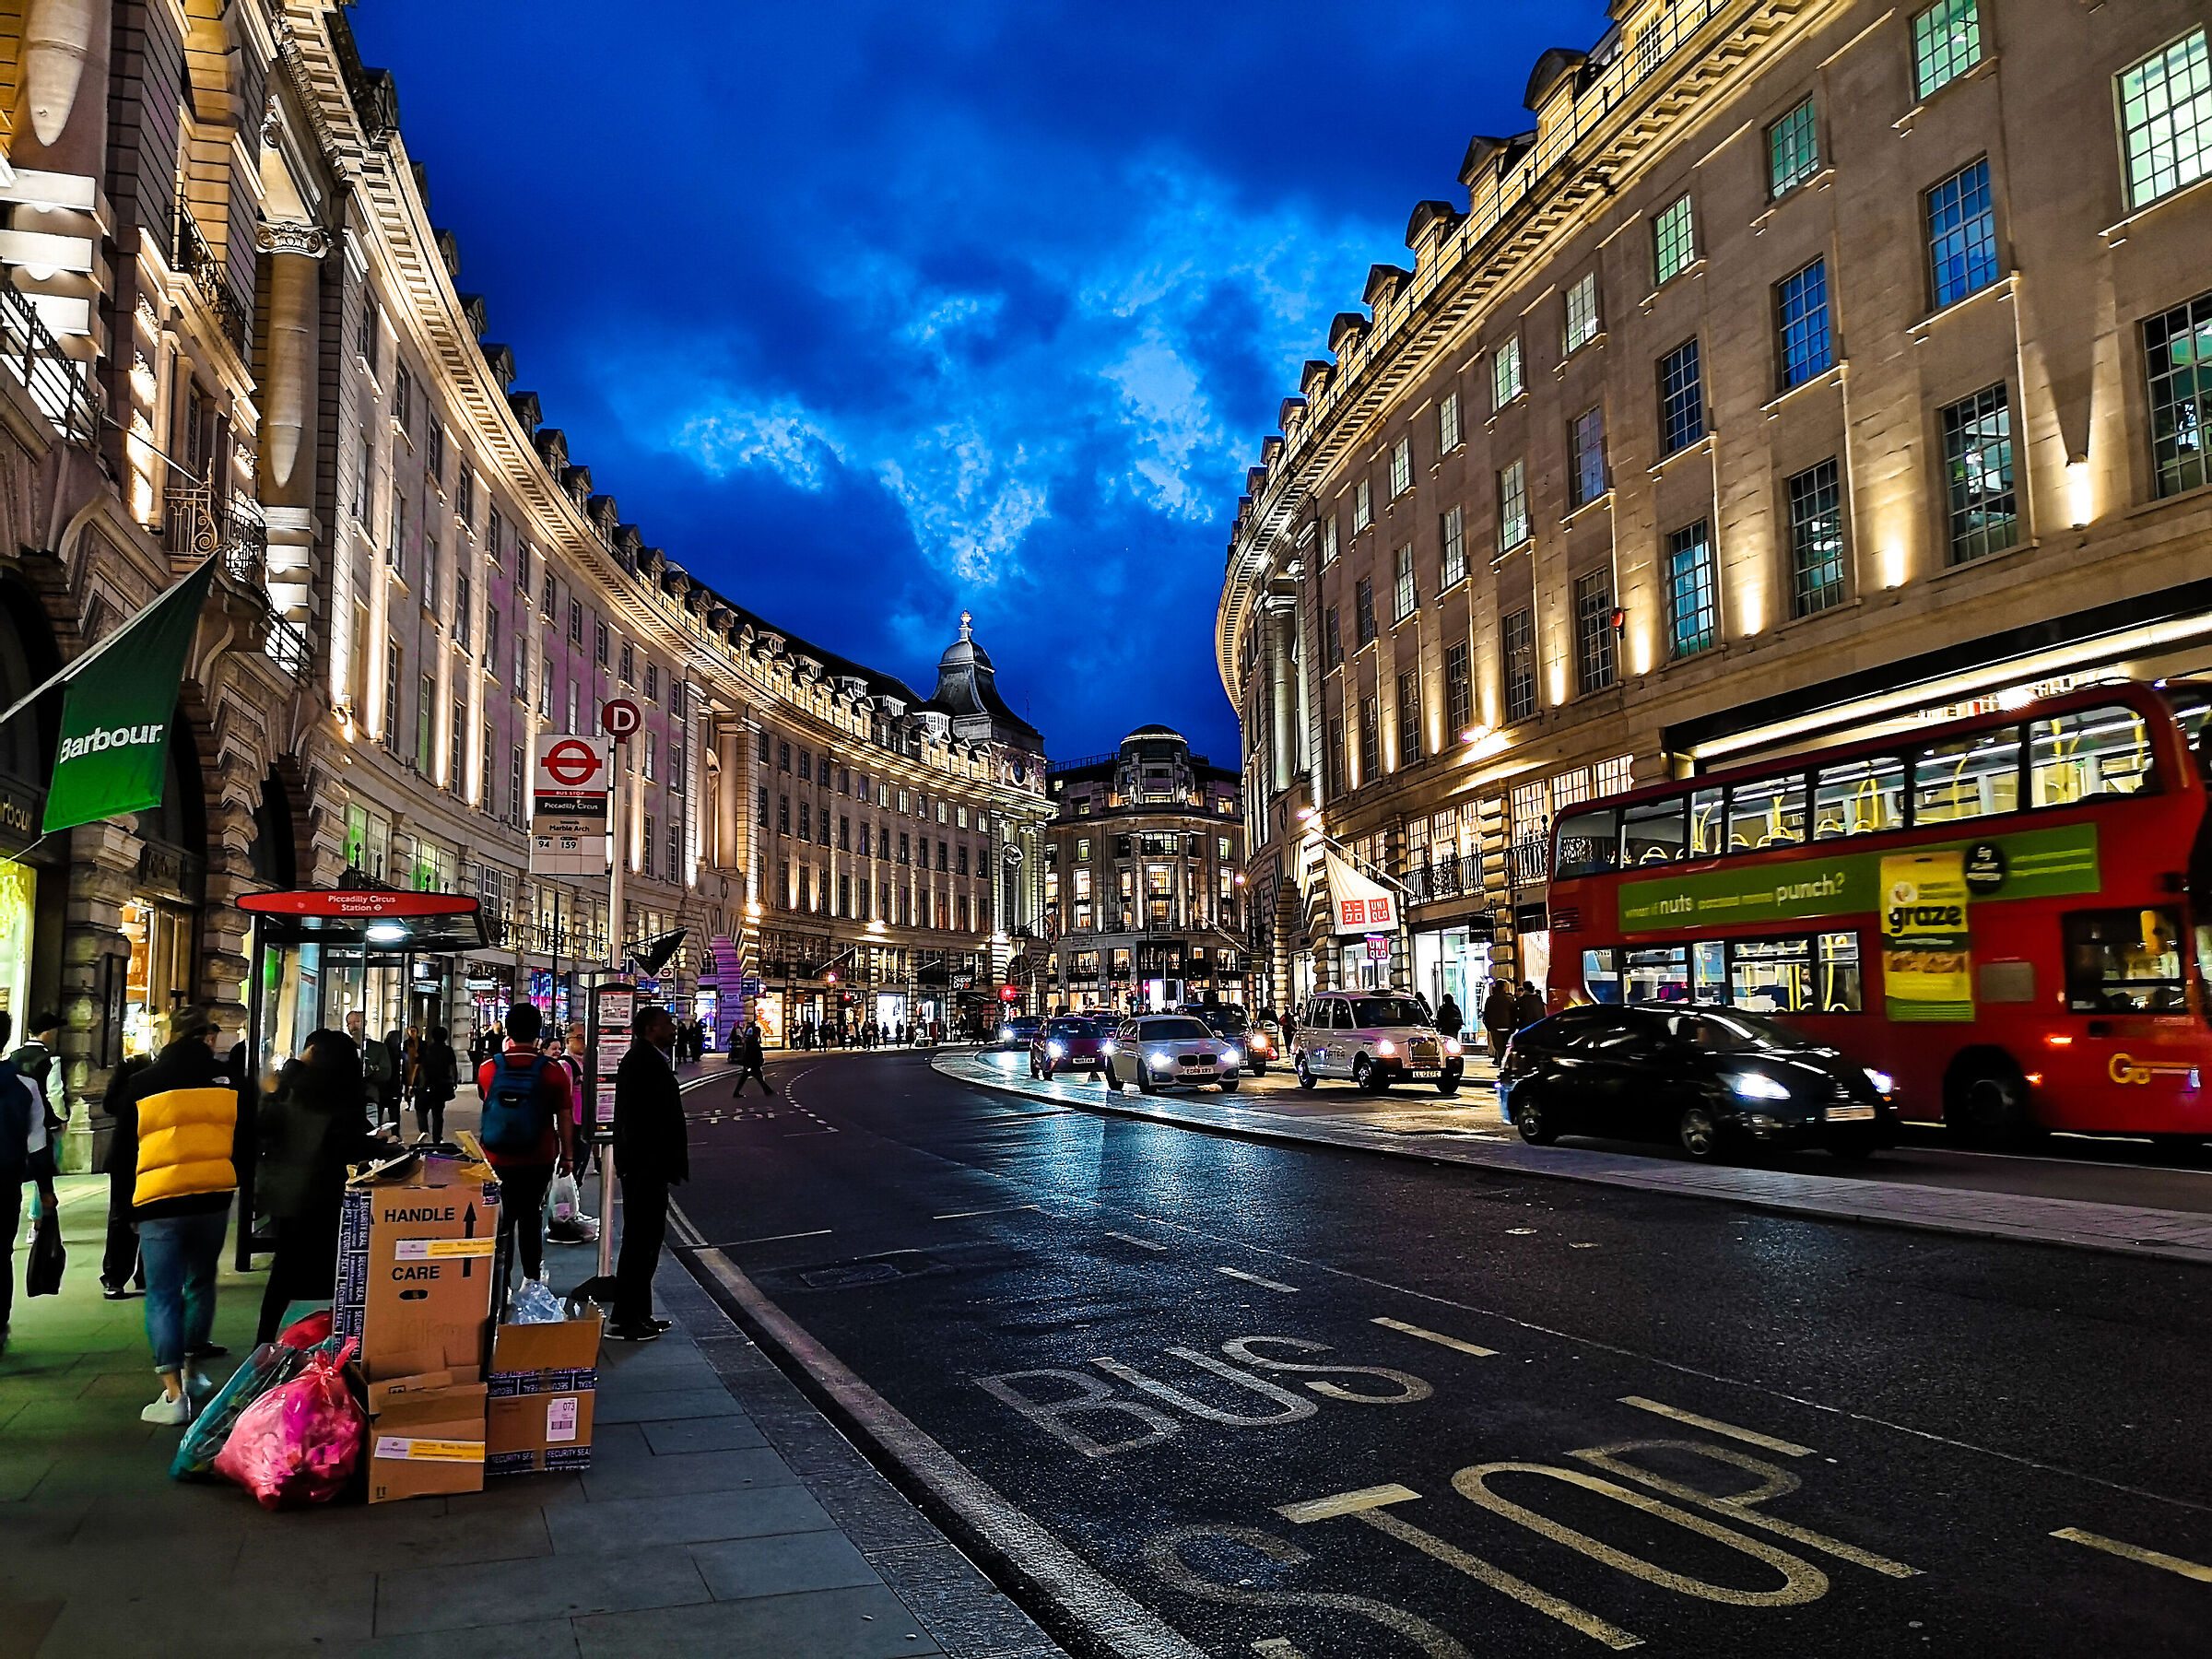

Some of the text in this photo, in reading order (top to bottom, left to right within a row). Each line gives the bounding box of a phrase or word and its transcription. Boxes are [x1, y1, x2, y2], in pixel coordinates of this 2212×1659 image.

[613, 707, 635, 731] D
[544, 802, 576, 810] Piccadilly
[538, 840, 577, 849] 94 159
[1776, 870, 1845, 907] punch?
[328, 895, 396, 904] Piccadilly Circus
[1660, 894, 1692, 915] nuts
[341, 903, 372, 912] Station
[1888, 905, 1962, 935] graze
[1369, 940, 1385, 950] UNI
[1370, 949, 1387, 959] QLO
[953, 975, 972, 983] Super
[953, 982, 965, 991] Dry
[384, 1206, 455, 1223] HANDLE
[359, 1201, 370, 1247] SECURITY SEAL
[355, 1255, 367, 1301] SECURITY SEAL
[392, 1265, 441, 1281] CARE
[335, 1282, 347, 1329] SECURITY SEAL
[972, 1335, 1434, 1458] BUS
[563, 1401, 575, 1412] 073
[491, 1453, 521, 1464] SECURITY
[547, 1449, 576, 1458] SECURITY
[1141, 1439, 1925, 1659] STOP
